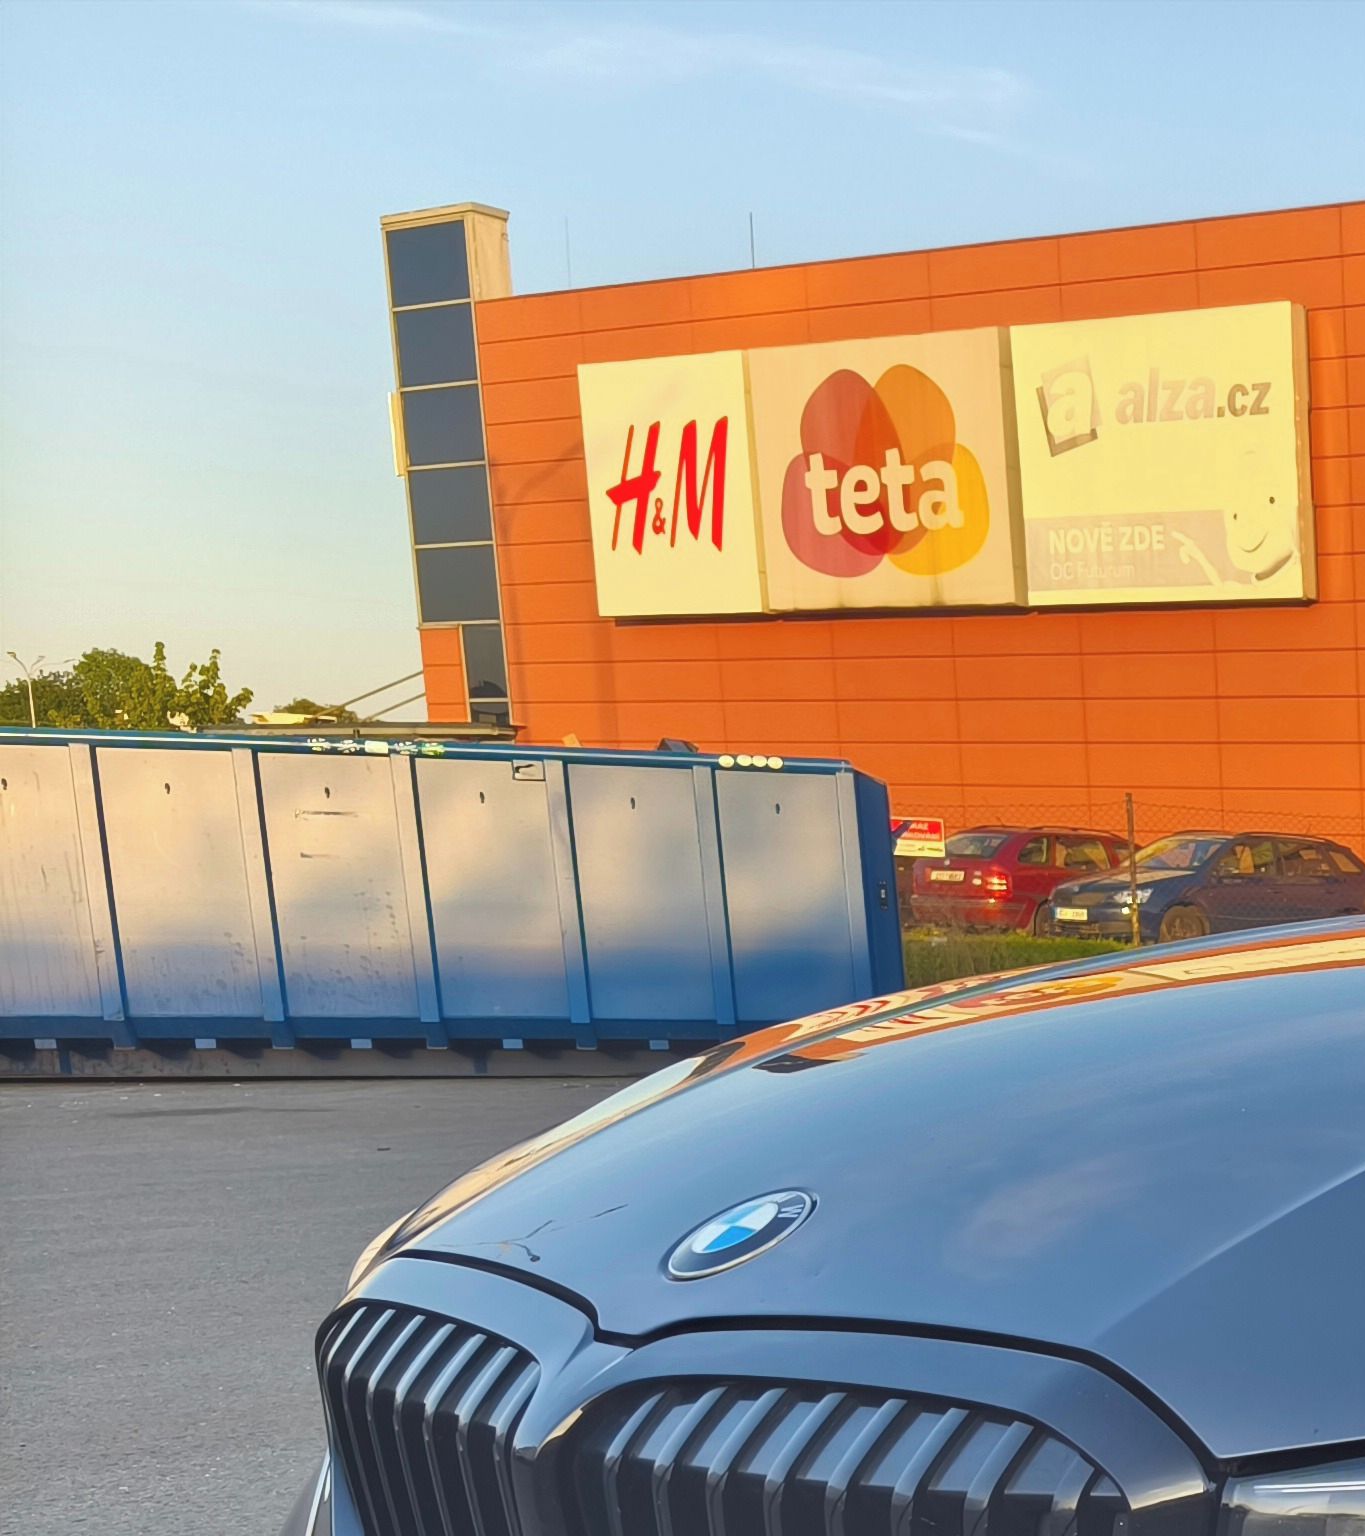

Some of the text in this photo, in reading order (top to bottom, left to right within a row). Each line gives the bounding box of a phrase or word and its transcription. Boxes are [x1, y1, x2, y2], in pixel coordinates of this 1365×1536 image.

[1115, 367, 1272, 425] alza.cz
[605, 415, 729, 555] H&M
[804, 447, 965, 536] teta
[1049, 522, 1166, 555] NOVÉ ZDE
